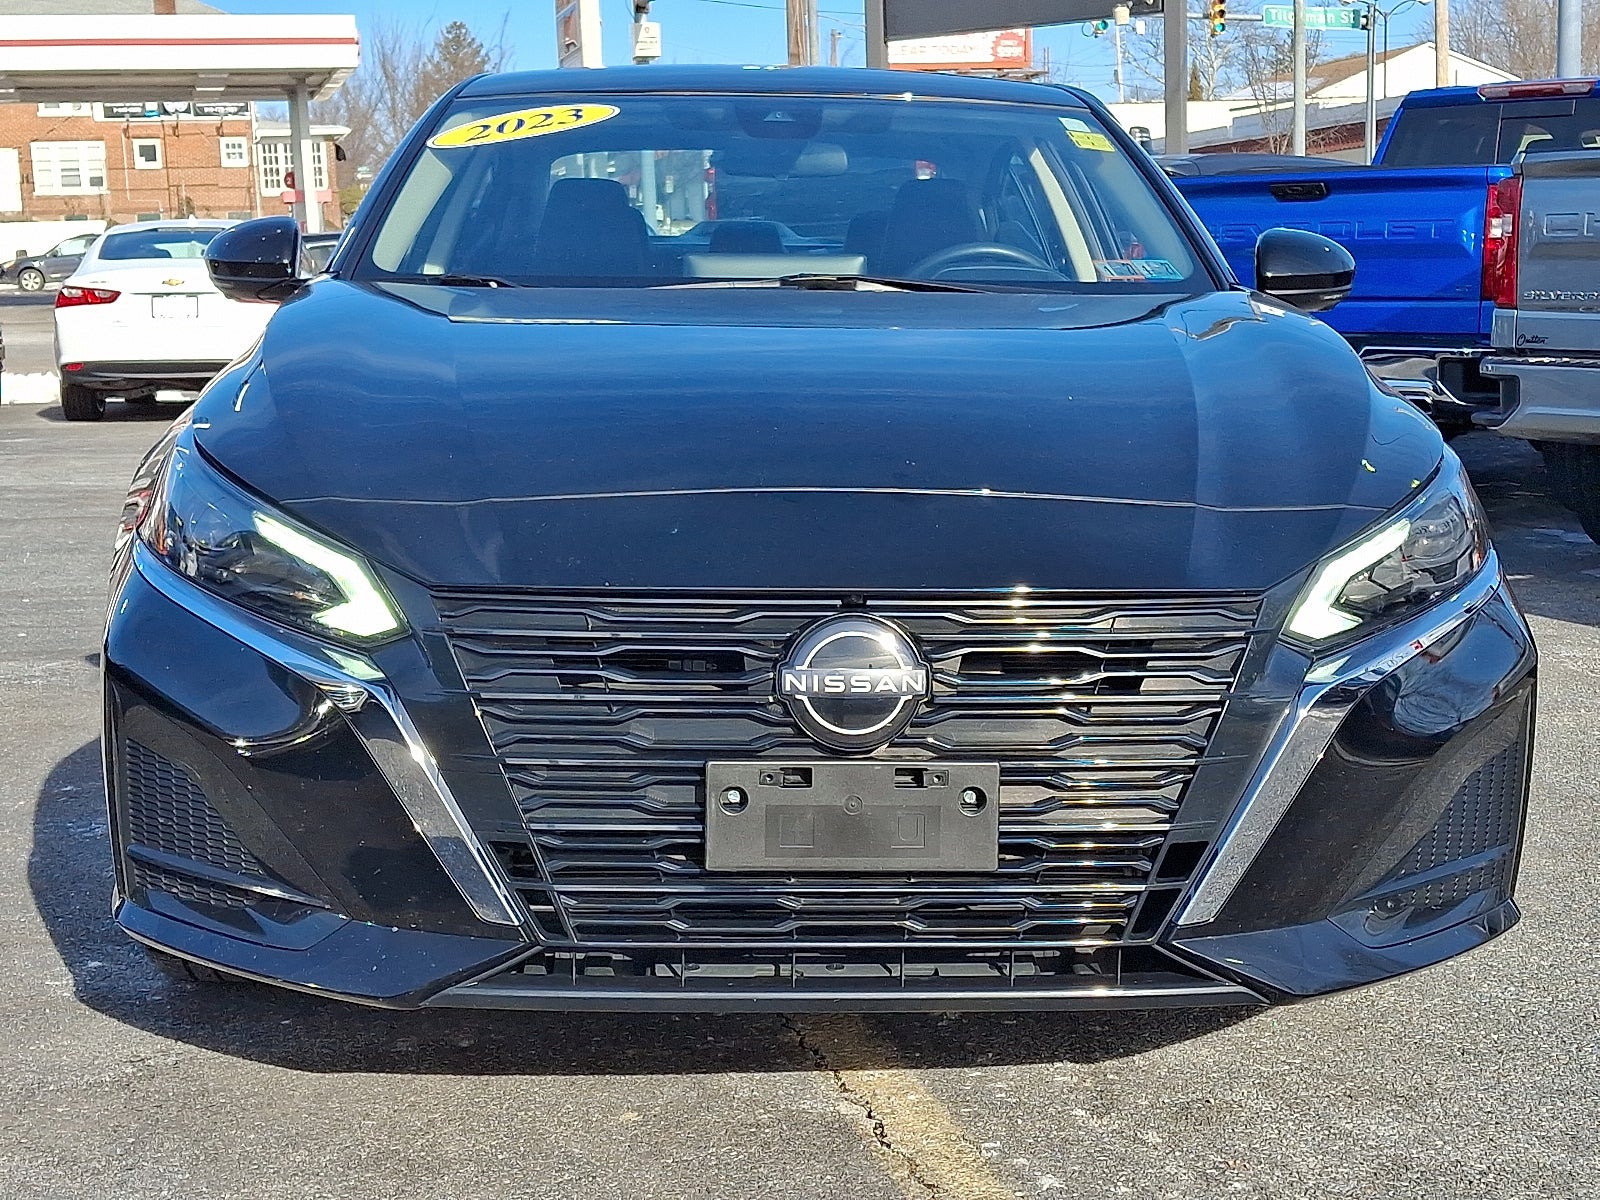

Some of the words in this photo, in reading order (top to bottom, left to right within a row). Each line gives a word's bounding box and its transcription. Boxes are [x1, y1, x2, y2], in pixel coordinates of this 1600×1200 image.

[1269, 8, 1335, 26] Tilgman
[1340, 11, 1355, 24] St
[464, 108, 584, 143] 2023
[785, 673, 925, 694] NISSAN
